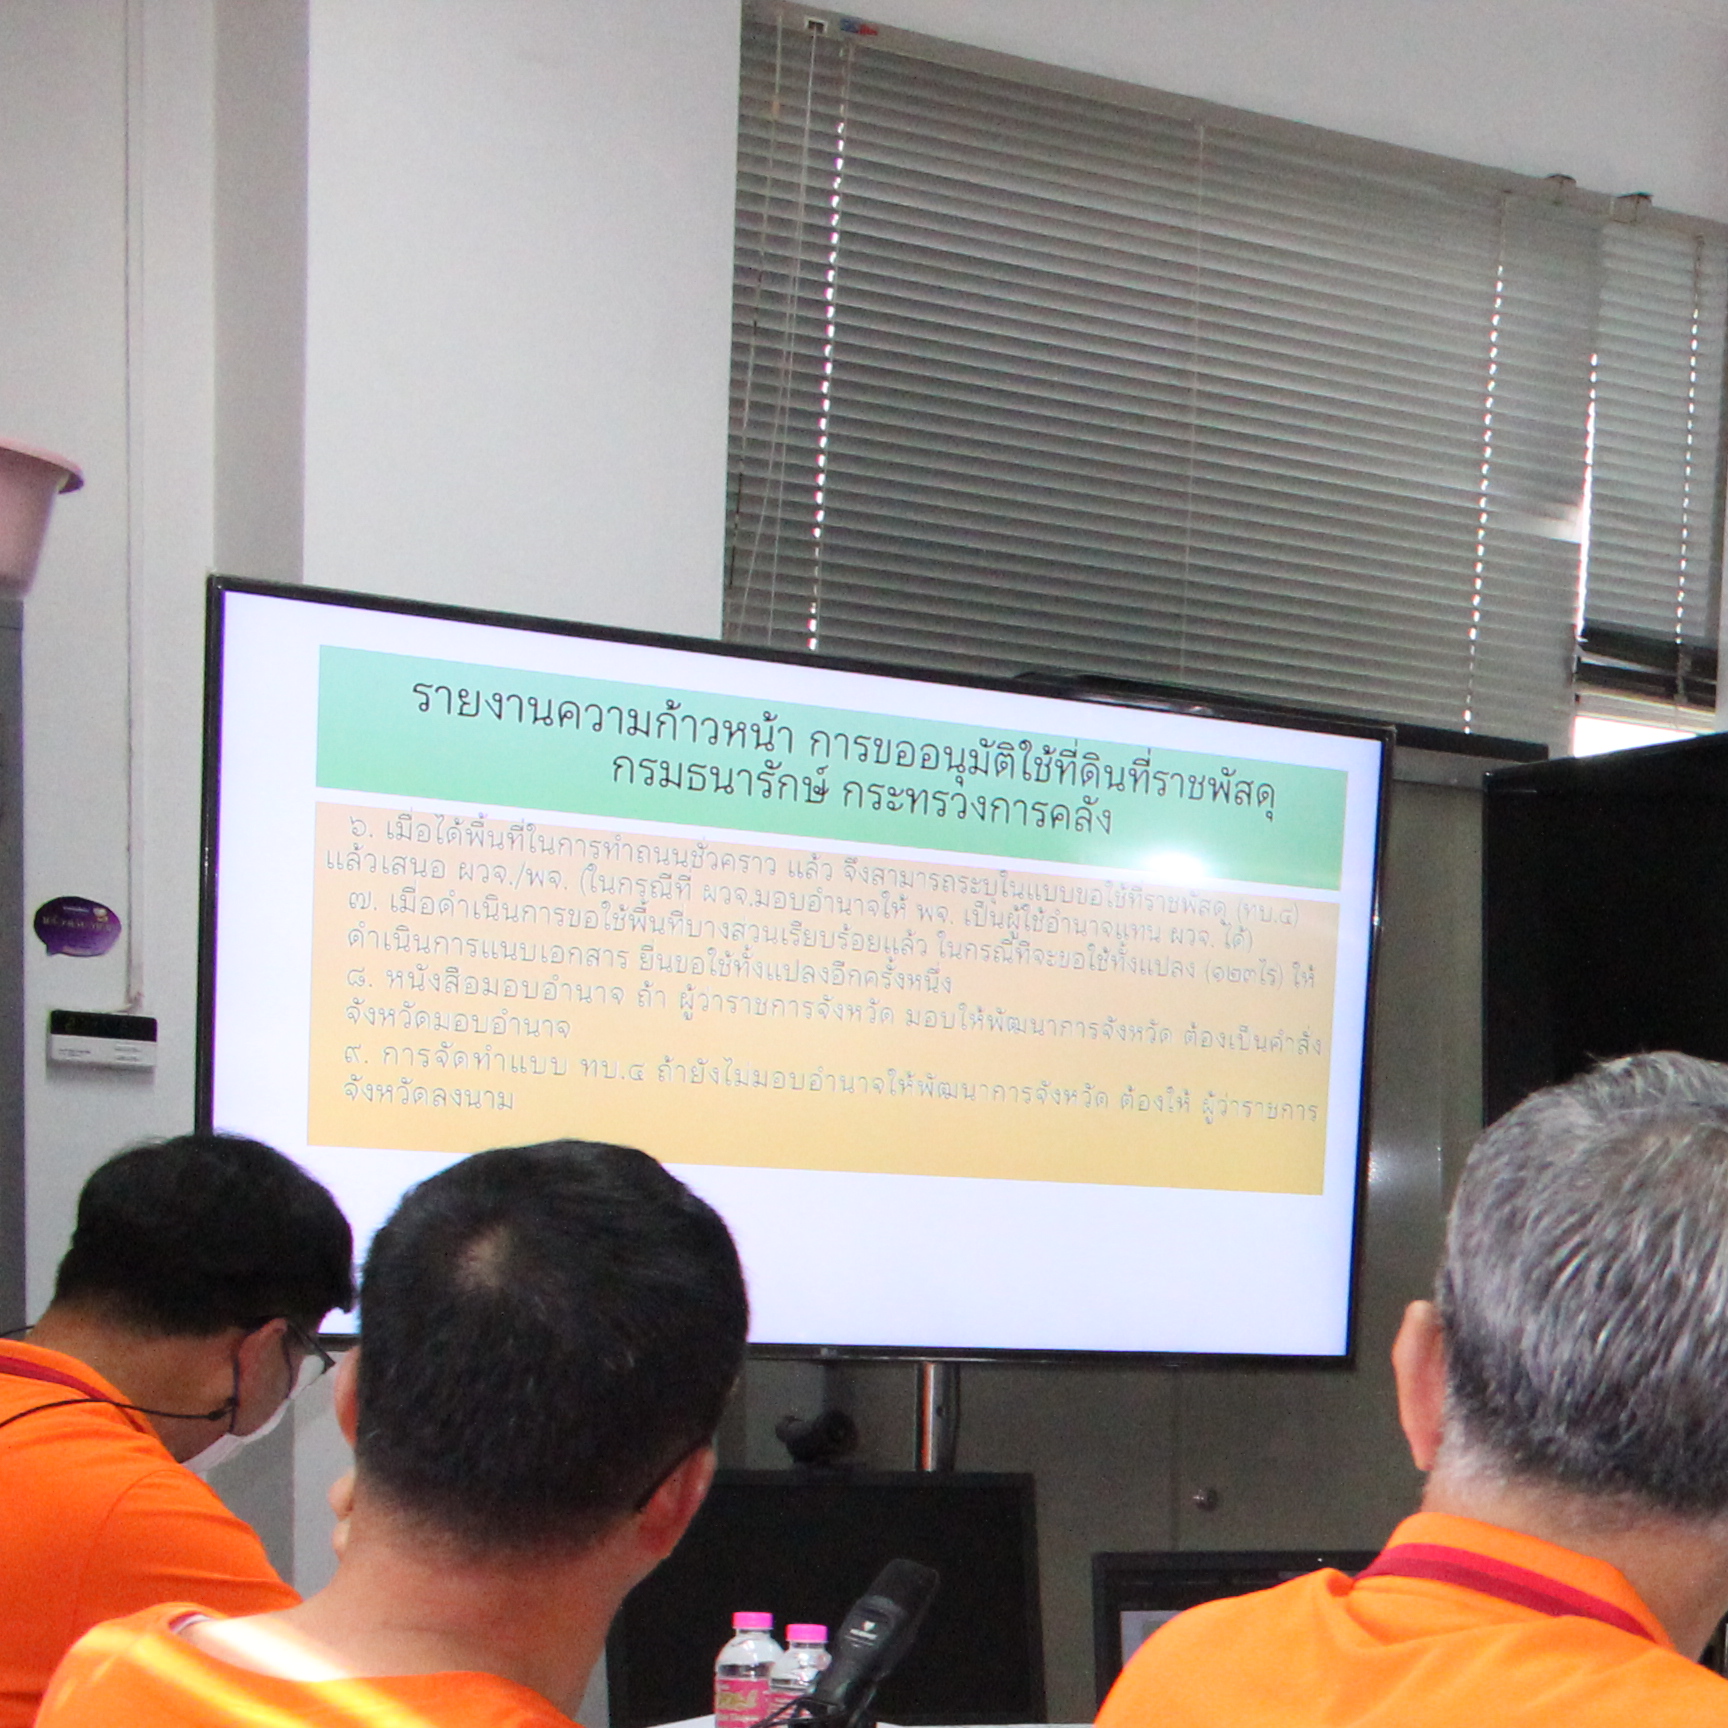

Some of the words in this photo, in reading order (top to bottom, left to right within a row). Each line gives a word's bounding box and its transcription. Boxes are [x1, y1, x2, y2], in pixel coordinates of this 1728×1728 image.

[412, 681, 794, 754] รายงานความก้าวหน้า
[809, 729, 1276, 822] การขออนุมัติใช้ที่ดินที่ราชพัสดุ
[612, 754, 829, 804] กรมธนารักษ์
[843, 778, 1113, 836] กระทรวงการคลัง
[325, 842, 446, 879] แล้วเสนอ
[788, 853, 833, 881] แล้ว
[347, 921, 630, 970] ดำเนินการแนบเอกสาร
[345, 997, 572, 1039] จังหวัดมอบอำนาจ
[385, 963, 626, 1006] หนังสือมอบอำนาจ
[637, 979, 666, 1009] ถ้า
[679, 983, 895, 1025] ผู้ว่าราชการจังหวัด
[905, 1001, 1173, 1046] มอบให้พัฒนาการจังหวัด
[382, 1041, 569, 1077] การจัดทำแบบ
[343, 1073, 515, 1112] จังหวัดลงนาม
